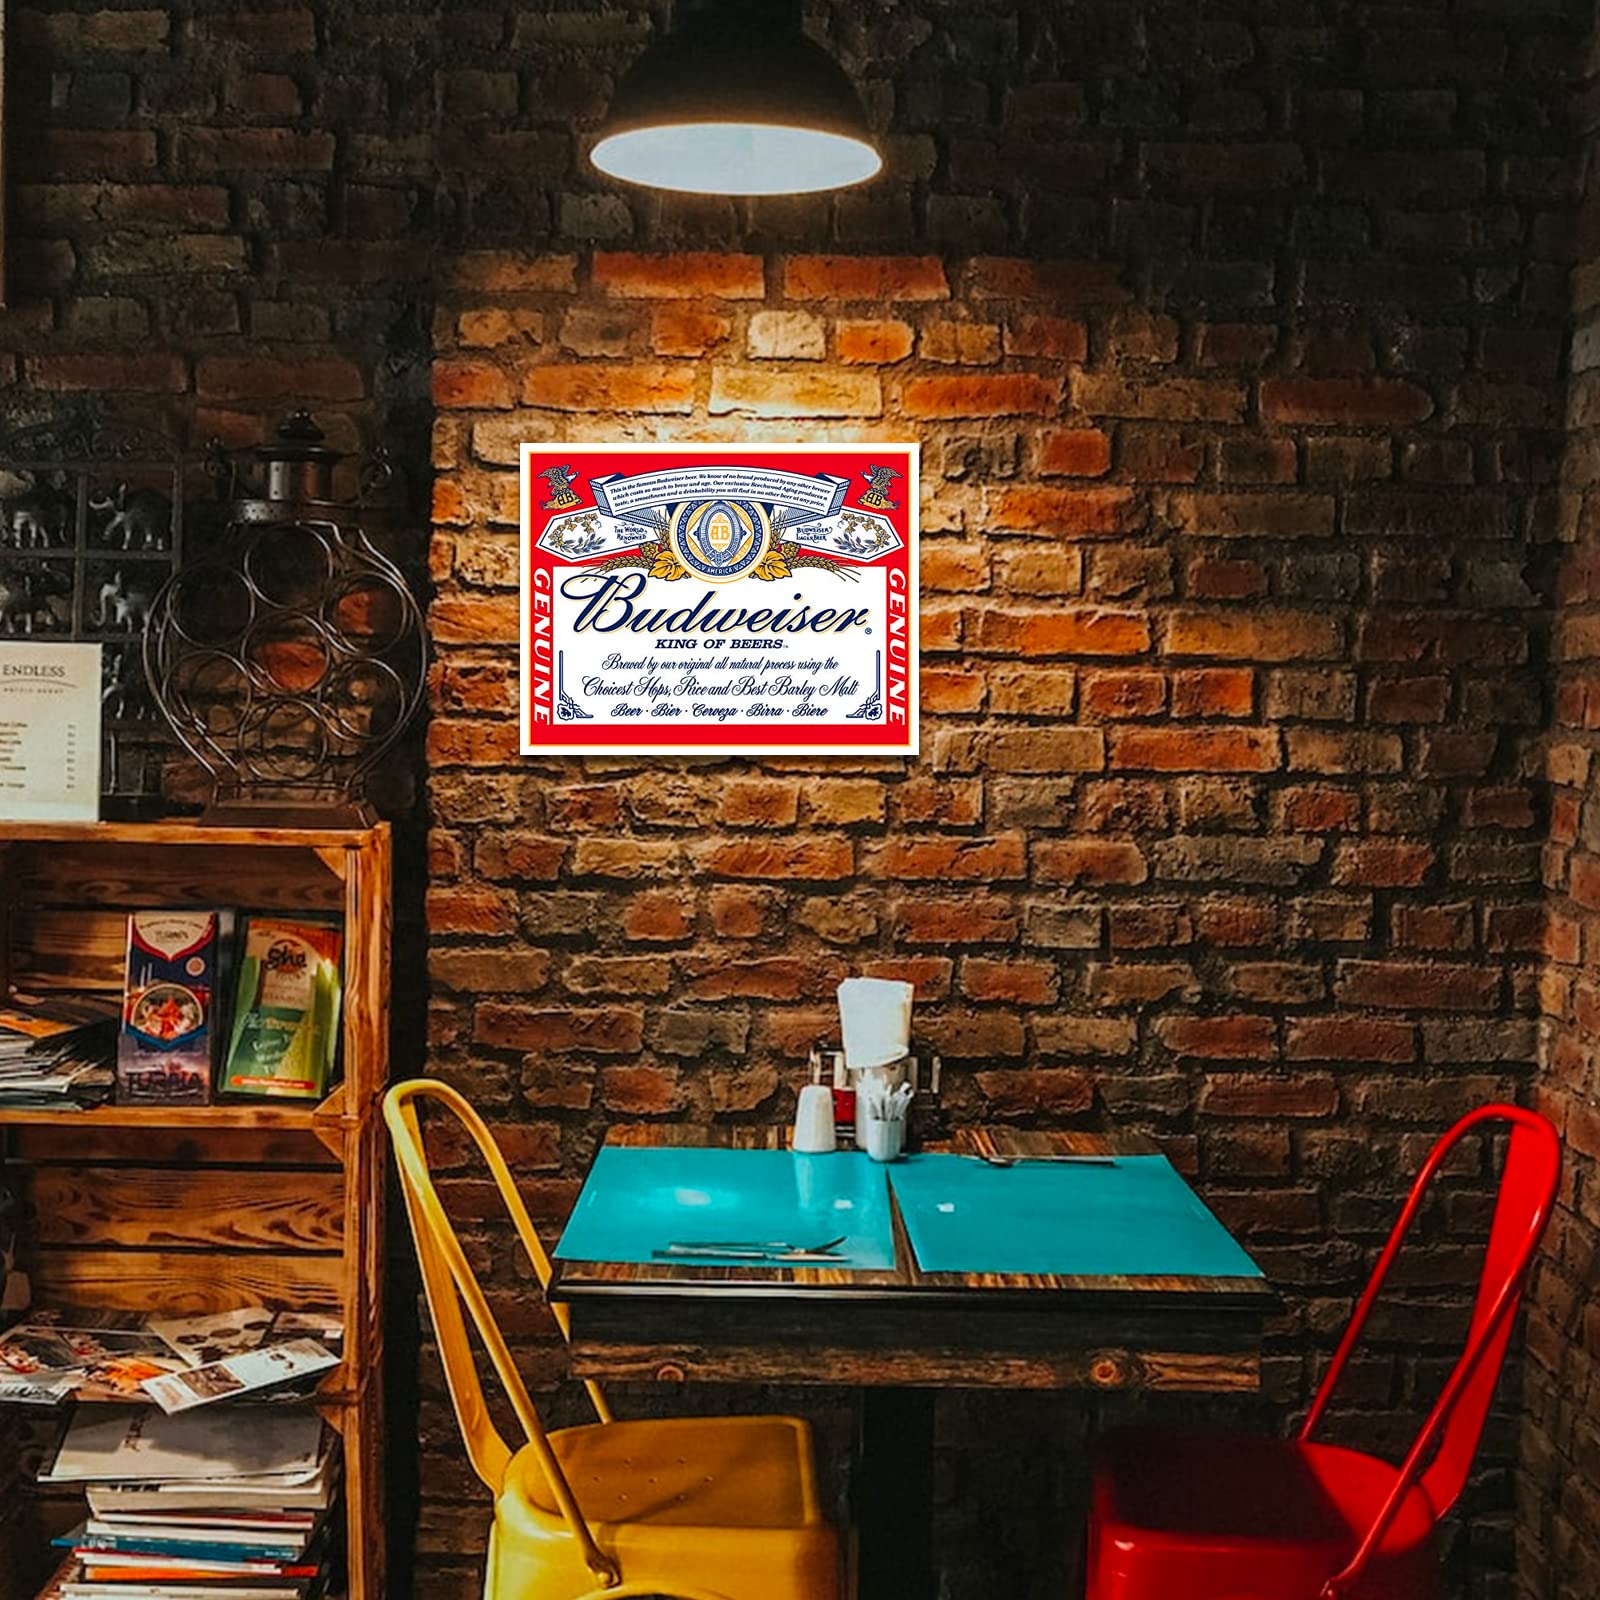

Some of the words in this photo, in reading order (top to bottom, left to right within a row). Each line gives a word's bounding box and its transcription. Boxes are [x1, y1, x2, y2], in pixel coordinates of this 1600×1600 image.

[612, 493, 629, 501] which
[751, 482, 781, 490] Beechwood
[782, 486, 797, 494] Aging
[798, 490, 823, 500] produces
[636, 480, 656, 488] famous
[657, 476, 684, 484] Budweiser
[812, 485, 831, 494] brewer
[635, 493, 666, 502] smoothness
[711, 525, 729, 540] AB
[707, 566, 733, 574] AMERICA
[560, 573, 870, 634] Budweiser
[534, 568, 550, 726] GENUINE
[655, 639, 698, 649] KING
[704, 639, 725, 649] OF
[730, 639, 783, 649] BEERS
[890, 568, 906, 726] GENUINE
[3, 664, 66, 678] ENDLESS
[602, 653, 647, 670] Brewed
[647, 656, 658, 675] by
[660, 662, 677, 670] our
[678, 656, 715, 675] original
[714, 656, 729, 670] all
[729, 657, 762, 670] natural
[760, 656, 796, 676] process
[797, 658, 823, 675] using
[823, 656, 839, 670] the
[582, 676, 634, 696] Choicest
[633, 676, 671, 703] Hops,
[673, 675, 711, 696] Rice
[708, 680, 733, 696] and
[732, 675, 768, 696] Best
[768, 675, 817, 702] Barley
[819, 675, 859, 697] Malt
[611, 703, 643, 717] Beer
[651, 703, 682, 717] Bier
[692, 703, 738, 721] Cerveza
[746, 703, 784, 717] Birra
[792, 703, 828, 717] Biere
